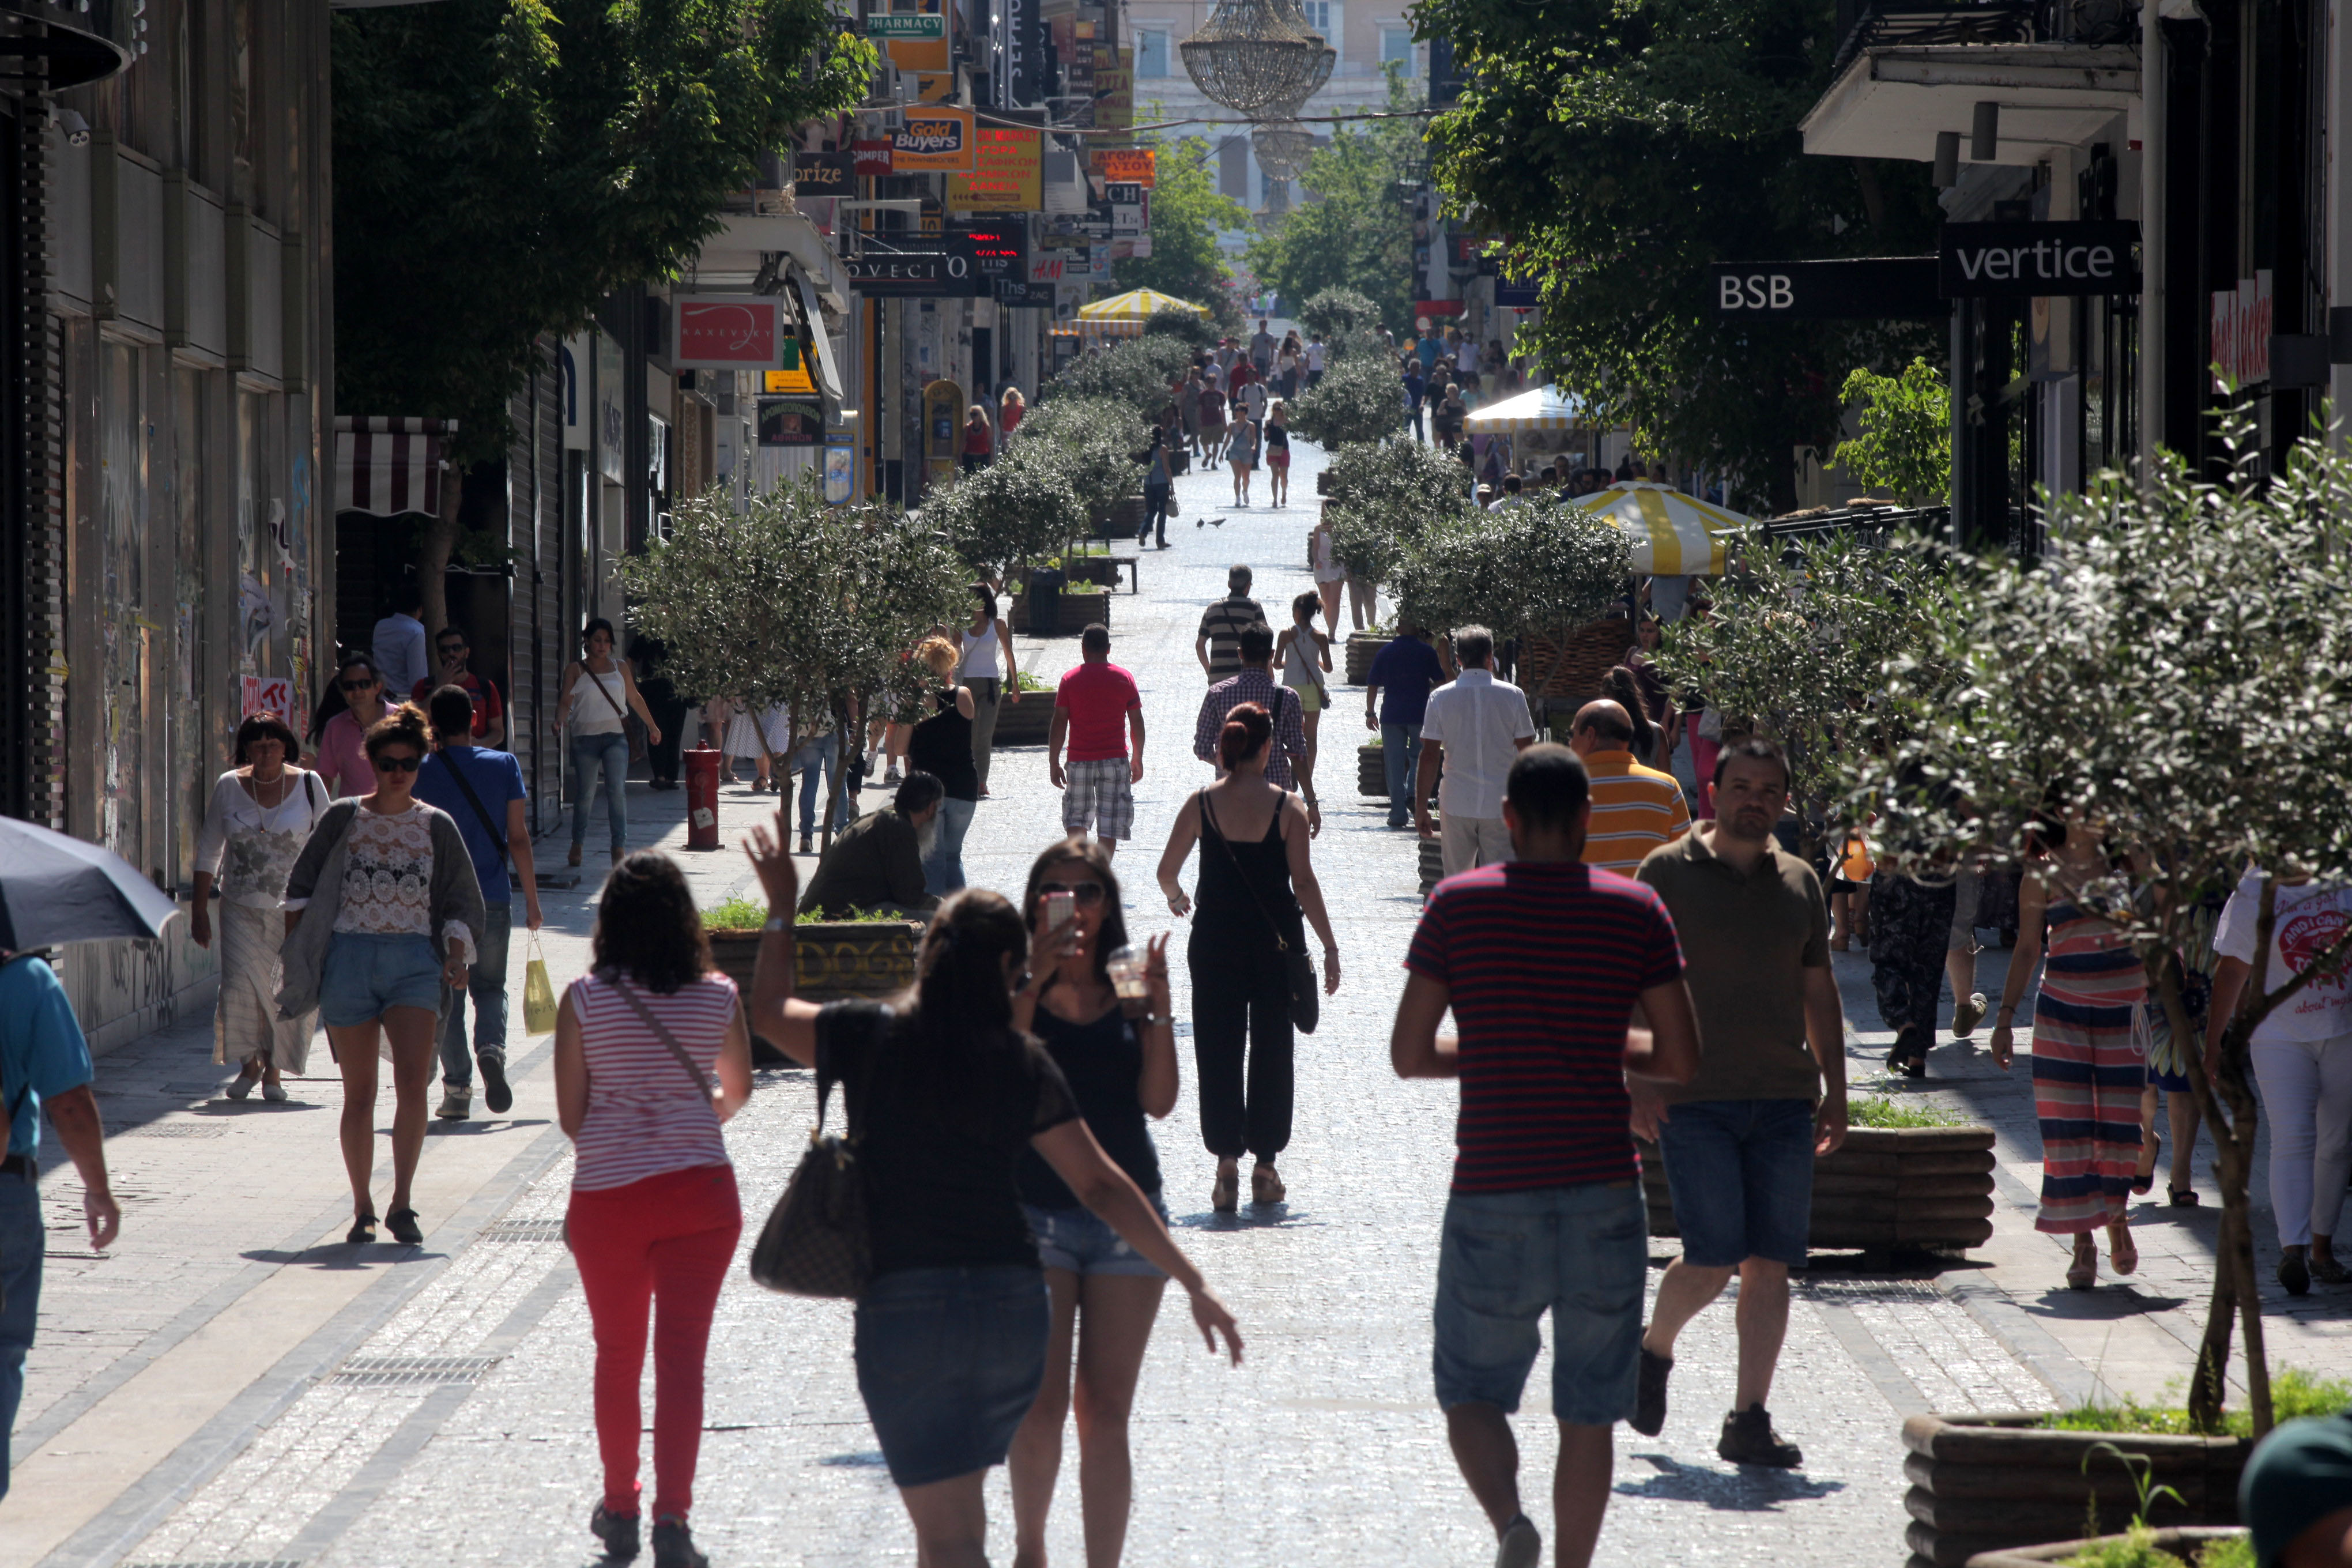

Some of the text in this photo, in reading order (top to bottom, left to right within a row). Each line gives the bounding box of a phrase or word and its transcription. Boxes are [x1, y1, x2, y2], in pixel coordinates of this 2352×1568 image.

[868, 18, 941, 29] PHARMACY
[910, 122, 951, 137] Gold
[896, 134, 958, 150] Buyers
[852, 150, 889, 164] CAMPER
[1097, 150, 1146, 161] ΑΓΟΡΑ
[968, 182, 1020, 191] ΔΑΝΕΙΑ
[1956, 239, 2114, 280] vertice
[997, 279, 1026, 295] Ths
[1720, 274, 1794, 308] BSB
[683, 328, 771, 337] RAXEVSKY
[2285, 920, 2307, 946] AND
